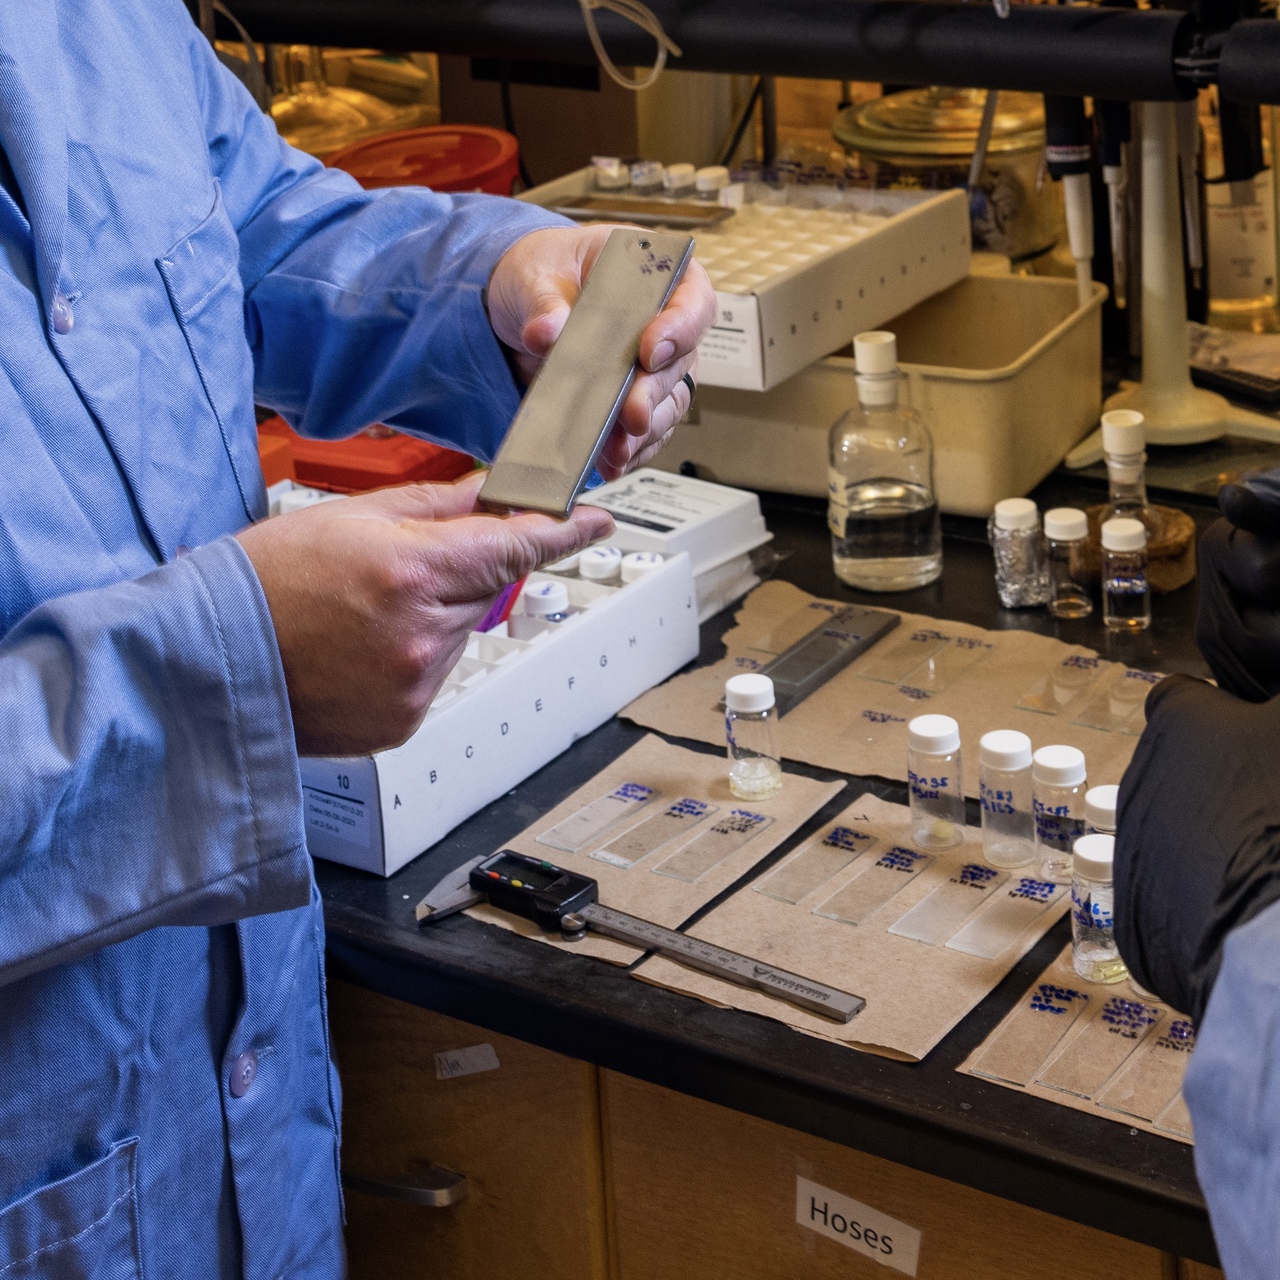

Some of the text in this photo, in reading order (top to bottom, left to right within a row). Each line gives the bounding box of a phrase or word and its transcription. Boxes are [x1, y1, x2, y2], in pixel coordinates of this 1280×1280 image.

[393, 794, 402, 810] A
[429, 770, 437, 784] B
[465, 745, 474, 759] C
[500, 722, 509, 736] D
[534, 698, 543, 713] E
[568, 676, 575, 690] F
[599, 654, 608, 668] G
[629, 635, 637, 647] H
[687, 595, 693, 609] J
[337, 773, 350, 790] 10
[811, 1196, 893, 1255] Hoses
